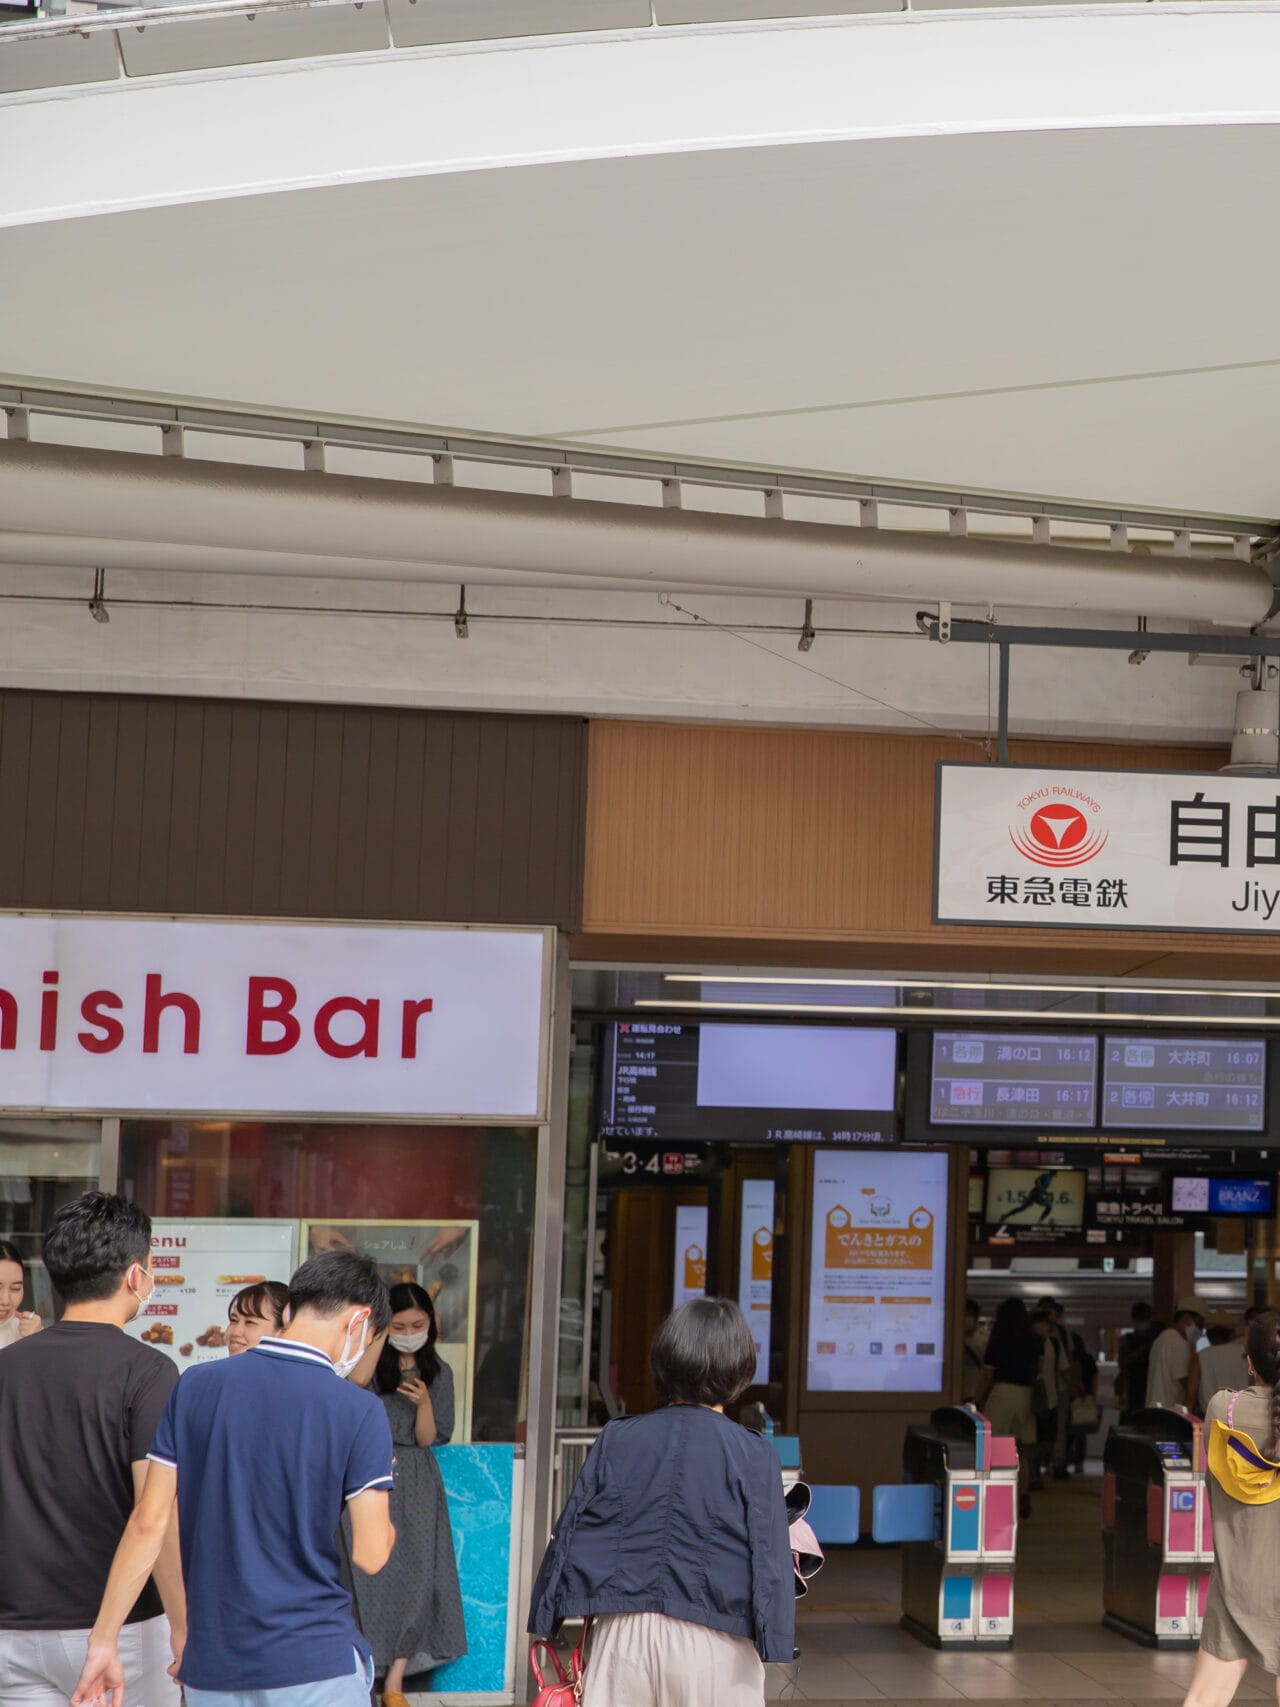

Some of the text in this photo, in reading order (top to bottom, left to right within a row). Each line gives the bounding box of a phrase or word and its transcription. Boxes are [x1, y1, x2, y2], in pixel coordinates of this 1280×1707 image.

[1017, 786, 1101, 813] TOKYU RAILWAYS
[986, 875, 1128, 908] 東急電鉄
[246, 976, 433, 1059] Bar
[1111, 1051, 1120, 1062] 2
[1168, 1049, 1211, 1066] 大井町
[1110, 1091, 1119, 1103] 2
[1167, 1091, 1210, 1107] 大井町
[150, 1235, 187, 1248] enu
[837, 1233, 923, 1248] でんきとガスの
[1172, 1491, 1193, 1510] IC
[954, 1622, 962, 1631] 4
[988, 1620, 996, 1630] 5
[1171, 1619, 1179, 1630] 5
